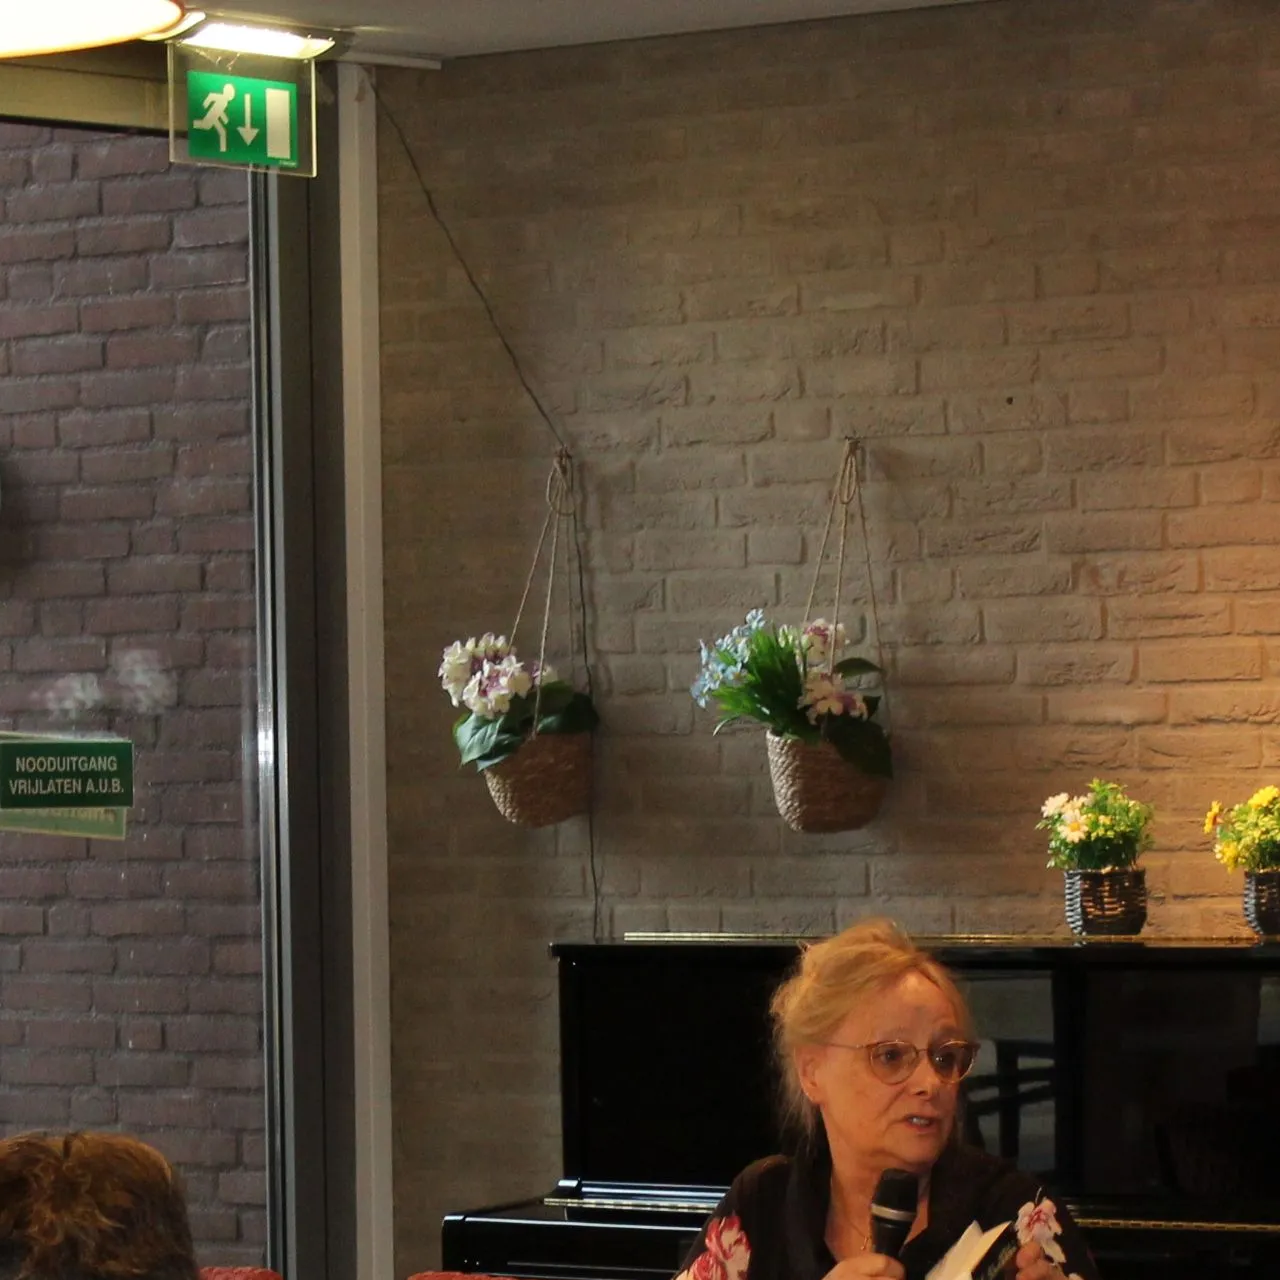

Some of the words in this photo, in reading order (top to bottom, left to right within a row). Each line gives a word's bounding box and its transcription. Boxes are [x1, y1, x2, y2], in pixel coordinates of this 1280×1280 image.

[15, 756, 118, 772] NOODUITGANG
[8, 779, 82, 795] VRIJLATEN
[85, 778, 125, 794] A.U.B.
